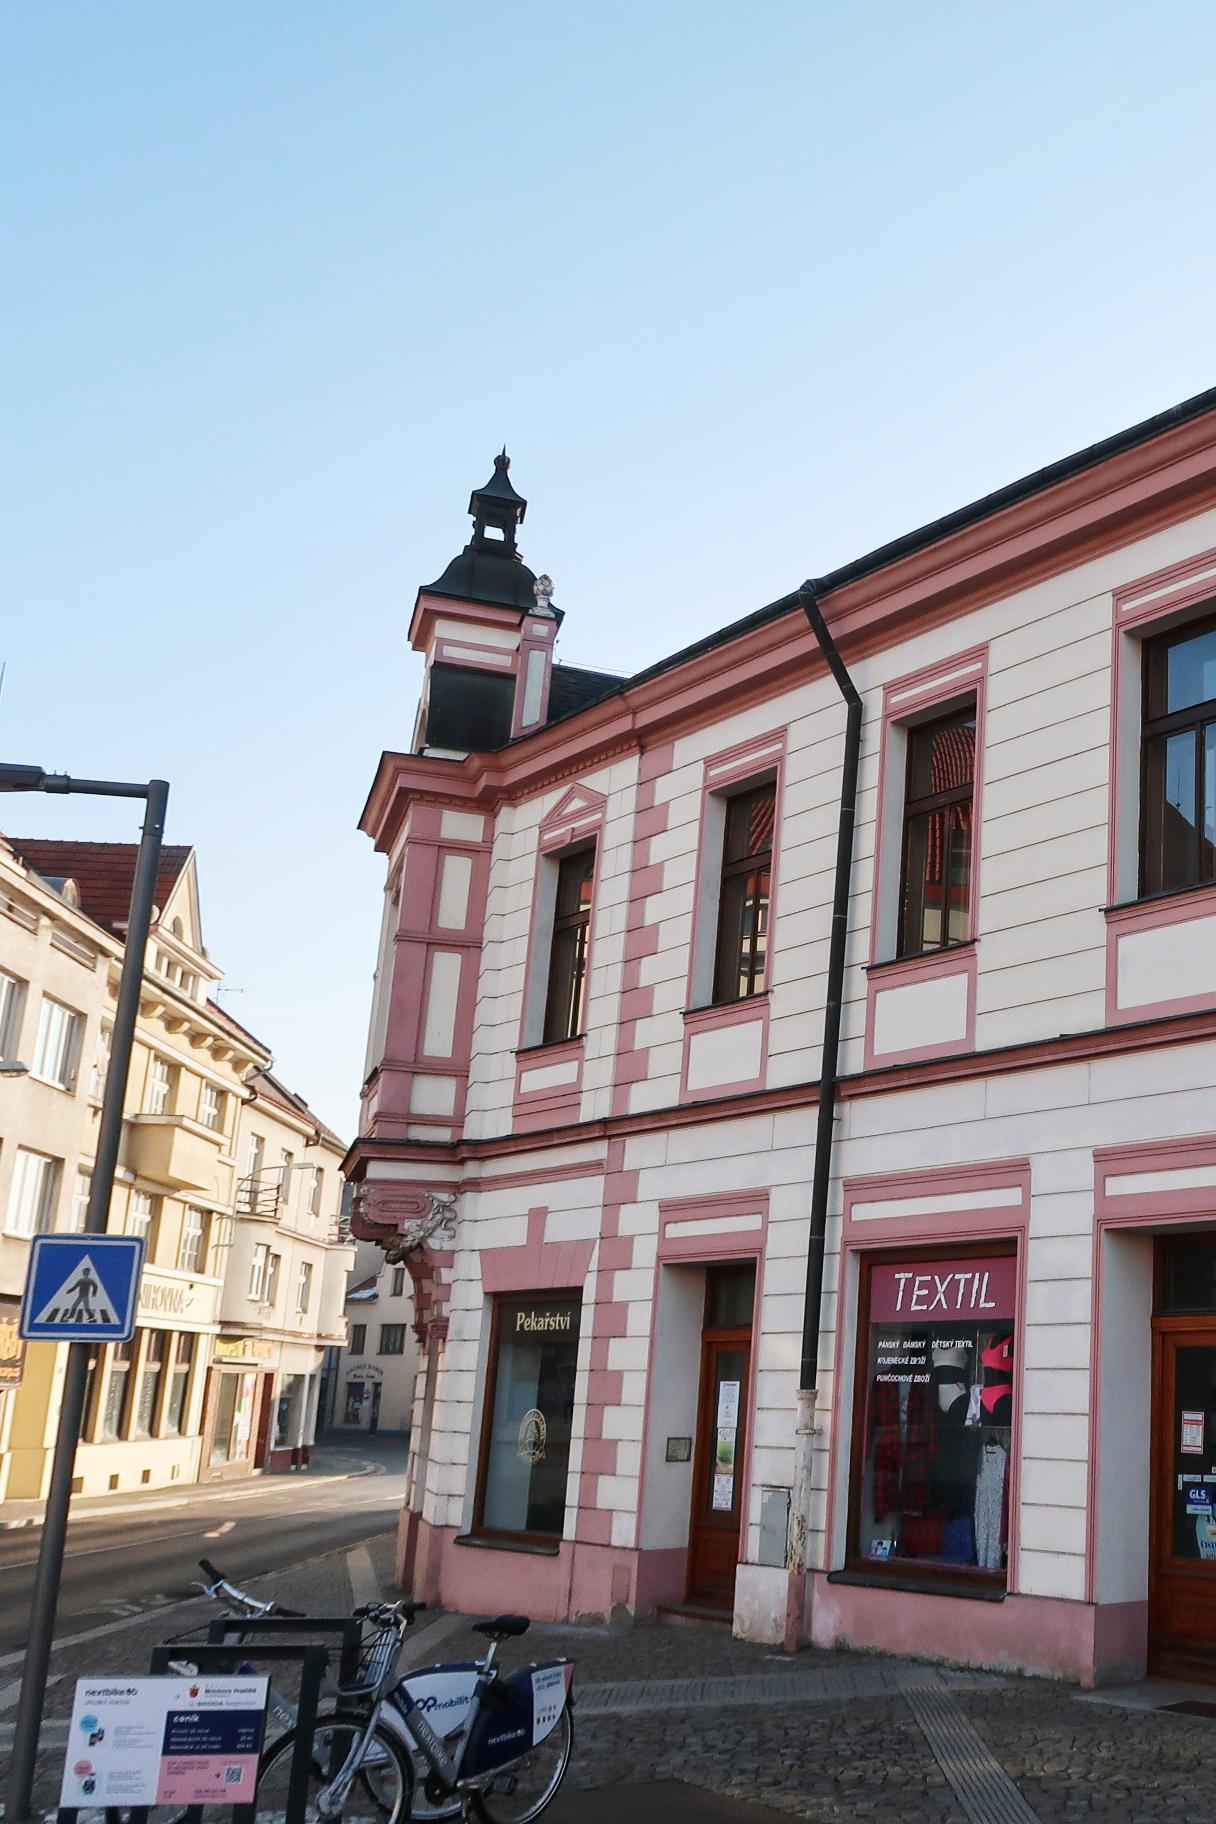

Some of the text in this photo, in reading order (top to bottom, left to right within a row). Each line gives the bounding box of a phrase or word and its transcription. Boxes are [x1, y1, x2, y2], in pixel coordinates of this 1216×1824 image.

[894, 1272, 996, 1311] TEXTIL
[515, 1311, 571, 1331] Pekařství
[877, 1338, 974, 1349] PÁNSKÝ DÁMSKÝ DĚTSKÝ TEXTIL
[1189, 1489, 1206, 1500] GLS
